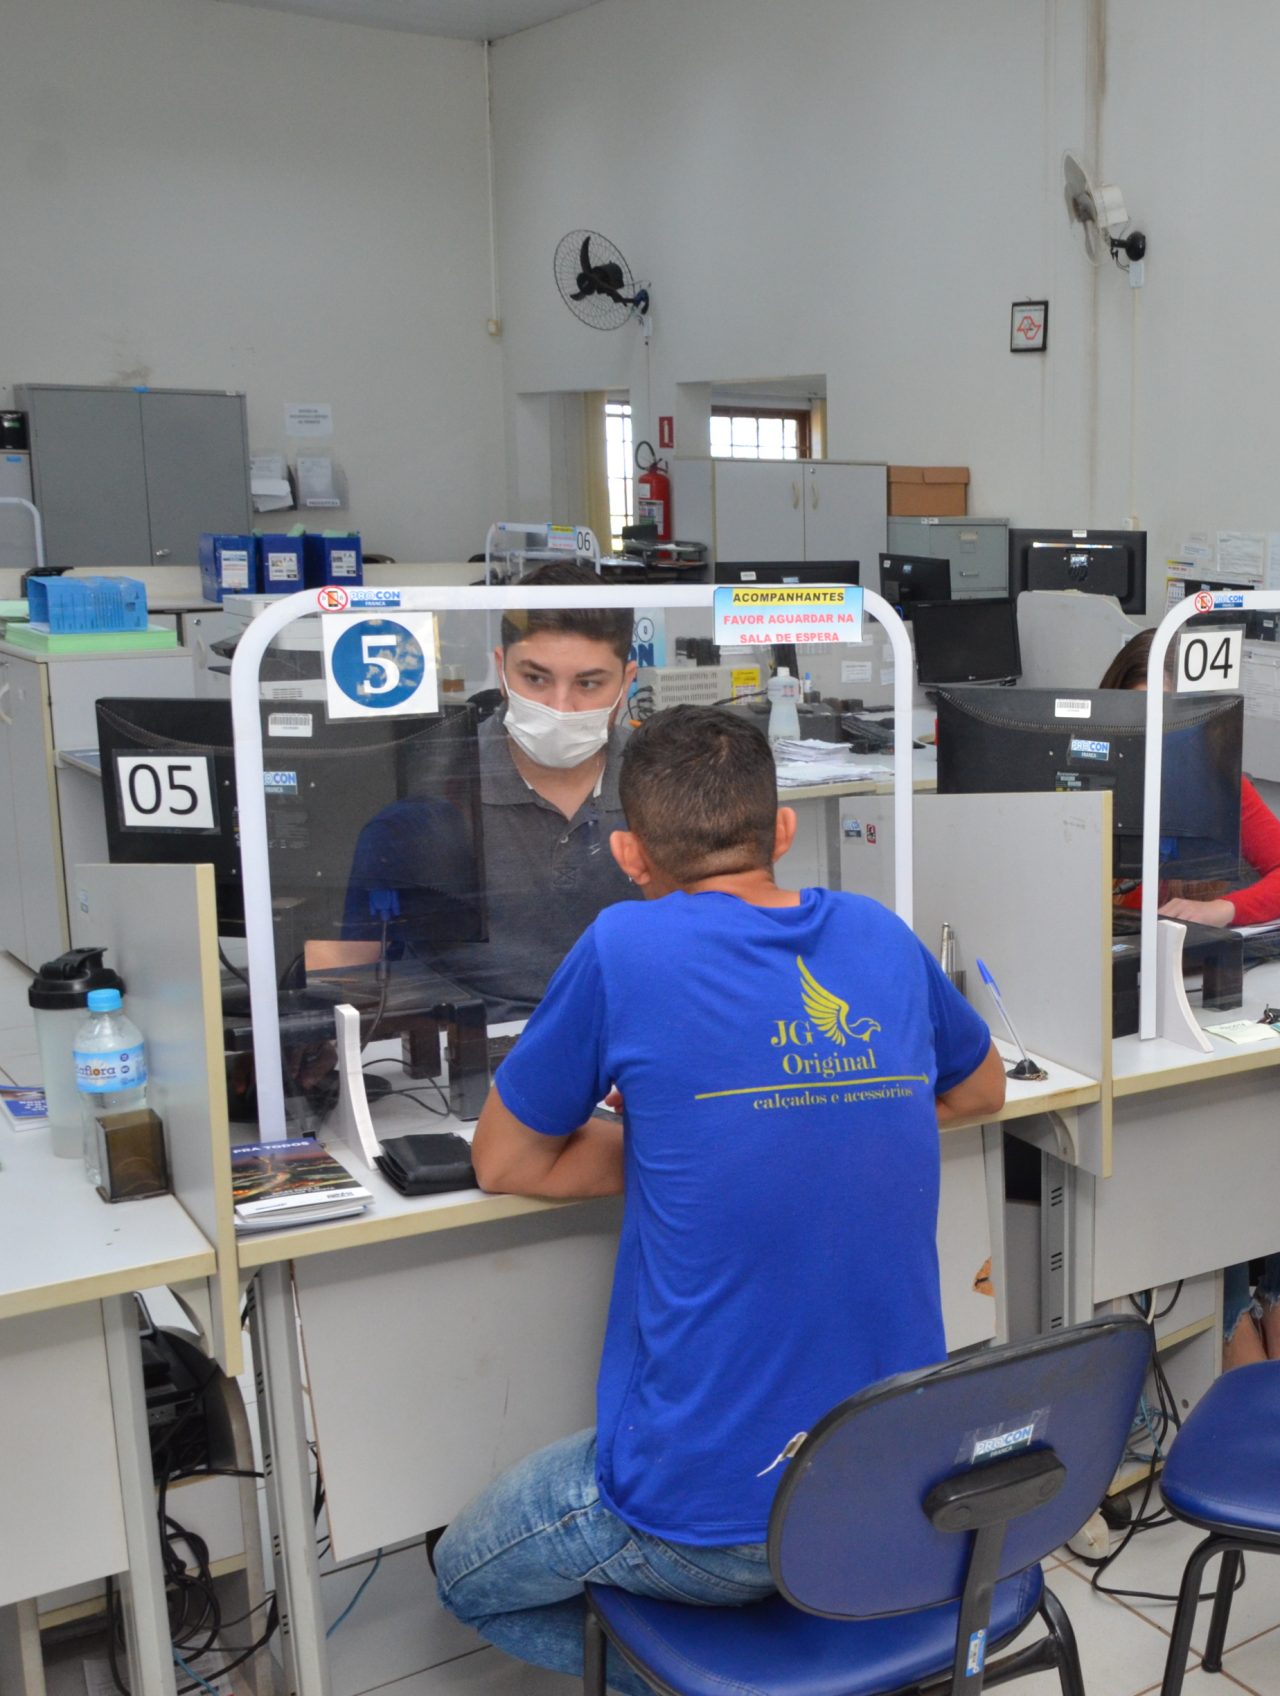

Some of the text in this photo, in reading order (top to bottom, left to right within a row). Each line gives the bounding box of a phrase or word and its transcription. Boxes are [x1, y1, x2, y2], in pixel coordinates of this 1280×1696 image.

[576, 531, 591, 551] 06
[350, 591, 400, 600] PROCON
[733, 592, 845, 602] ACOMPANHANTES
[723, 613, 854, 625] FAVOR AGUARDAR NA
[740, 632, 840, 644] SALA DE ESPERA
[361, 634, 401, 694] 5
[1184, 637, 1233, 682] 04
[128, 763, 198, 815] 05
[770, 1020, 813, 1047] JG
[782, 1048, 877, 1079] Original
[753, 1083, 913, 1110] calçados e acessórios
[264, 1141, 310, 1150] TODOS
